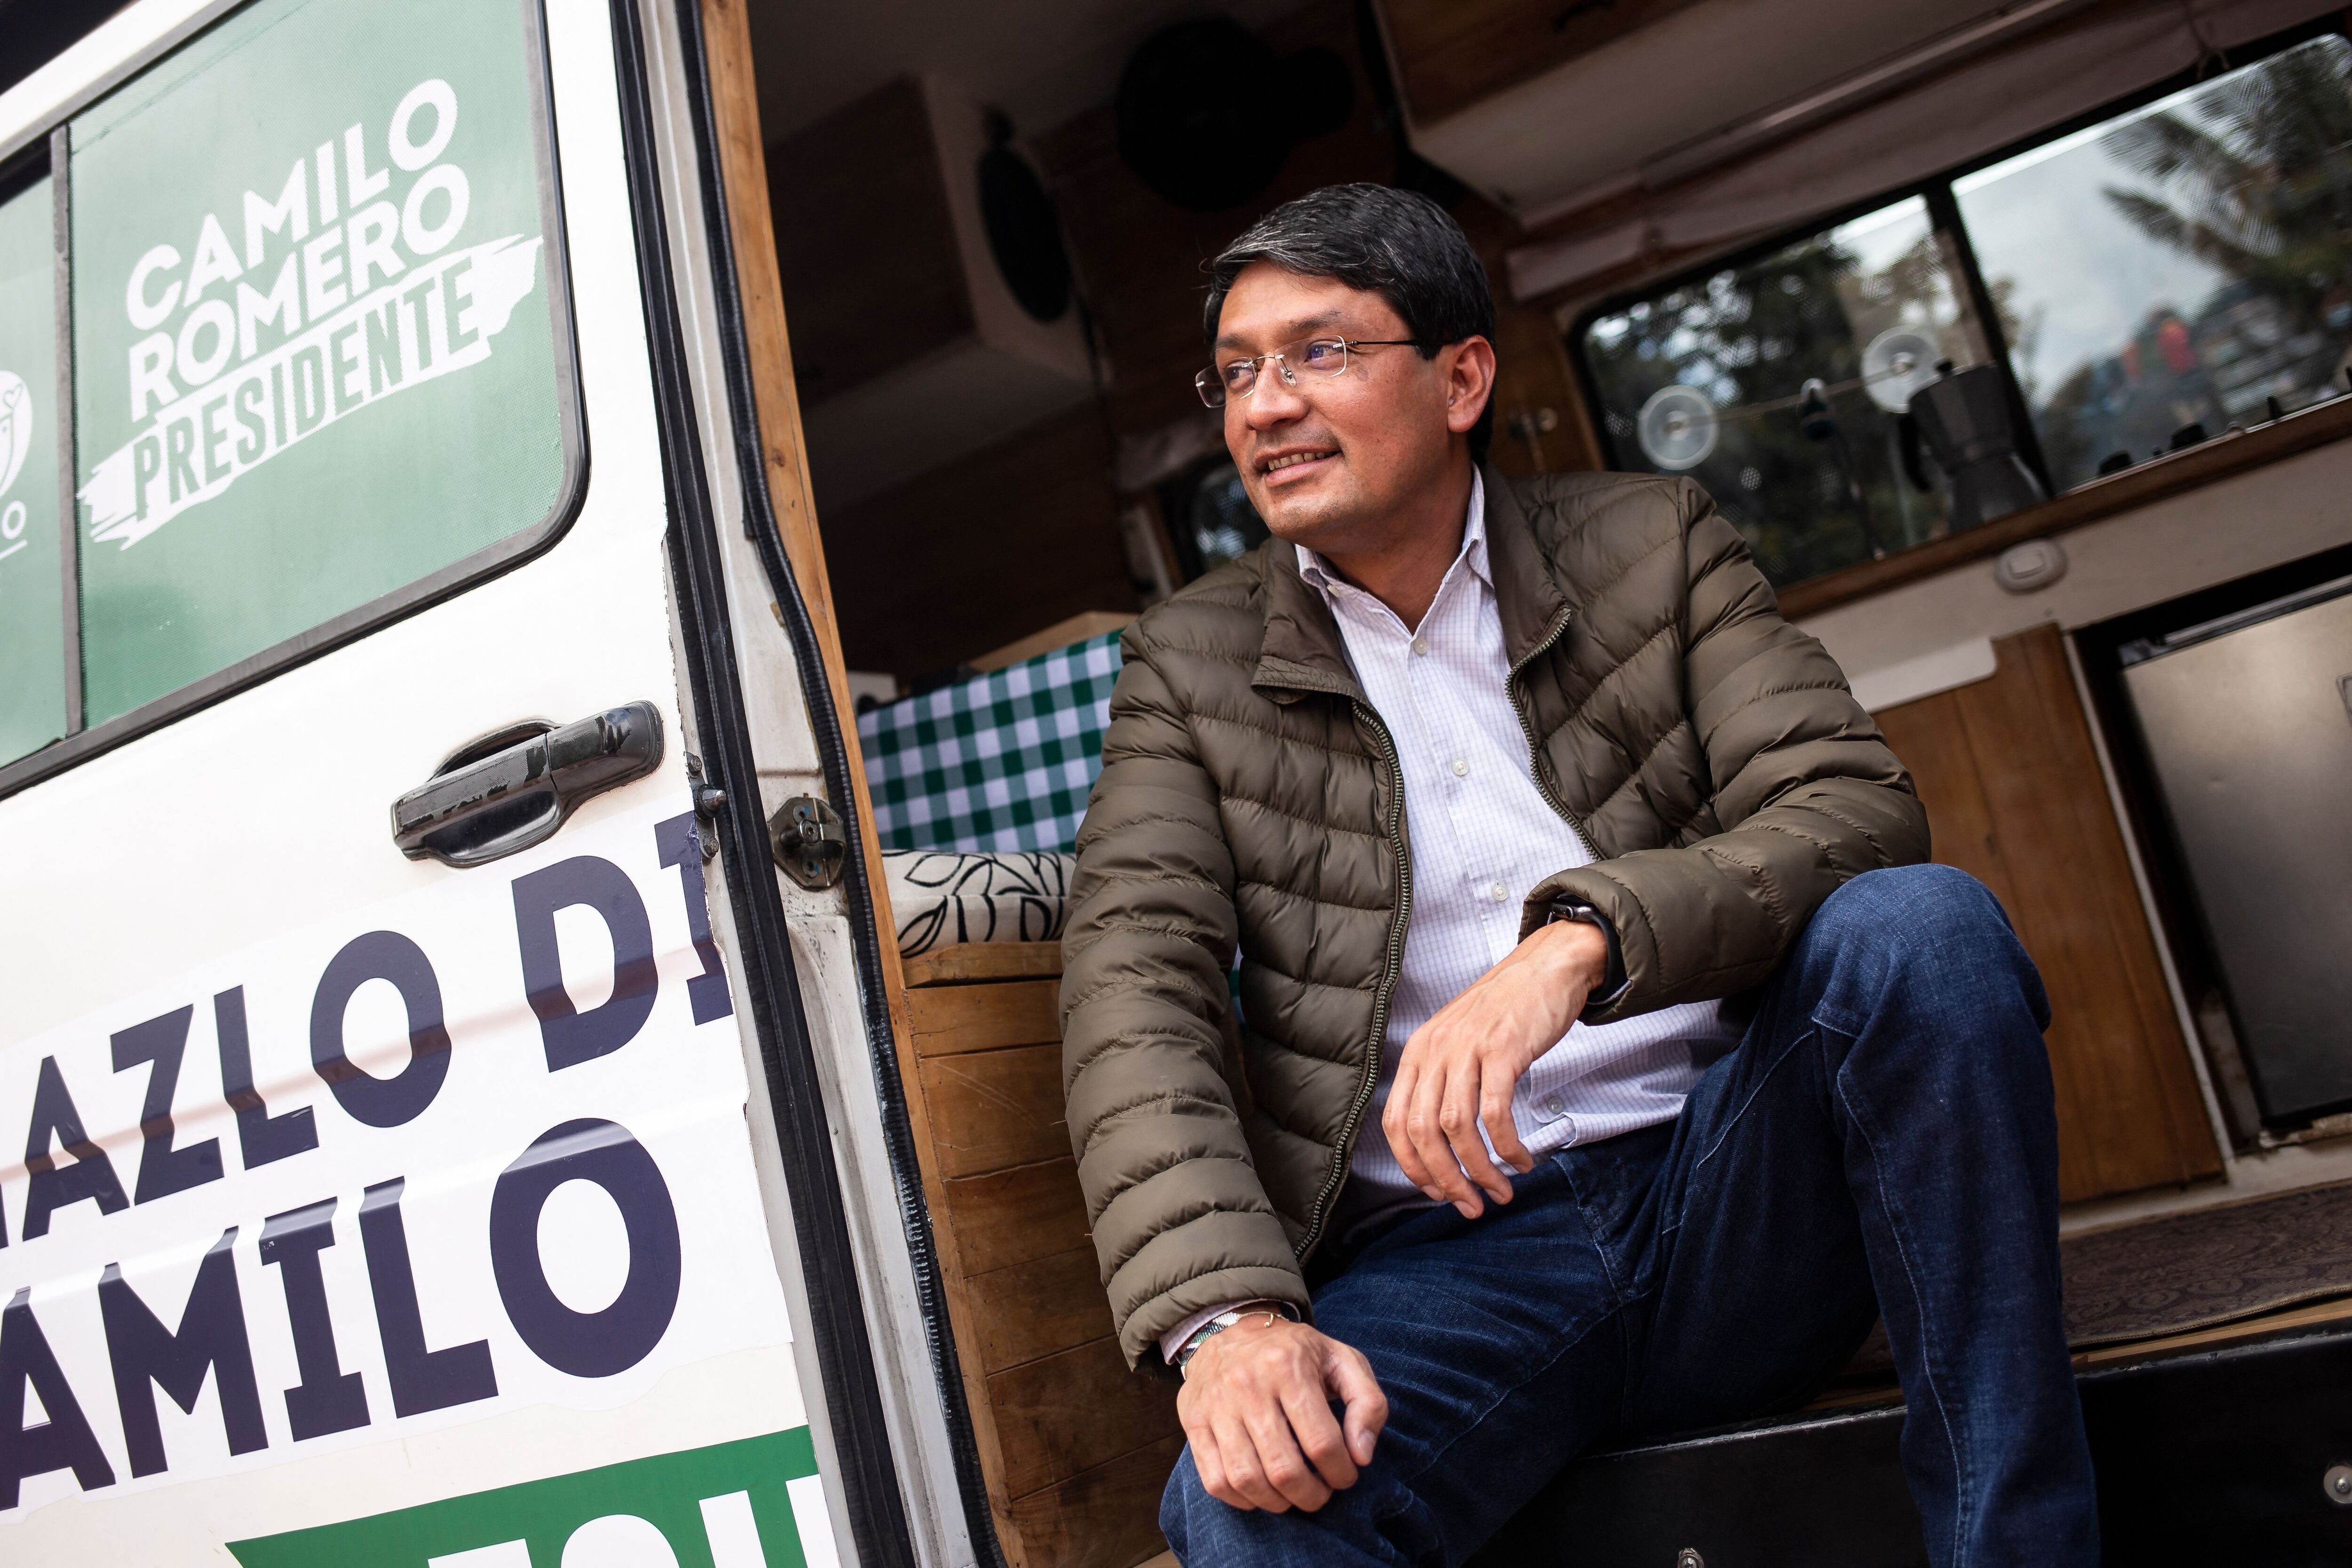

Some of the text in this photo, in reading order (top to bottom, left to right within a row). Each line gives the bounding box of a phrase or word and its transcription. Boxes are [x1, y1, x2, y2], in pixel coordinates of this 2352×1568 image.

[126, 78, 459, 331] CAMILO
[128, 163, 470, 423] ROMERO
[132, 261, 479, 523] PRESIDENTE
[0, 930, 452, 1249] AZLO
[0, 1117, 682, 1511] AMILO
